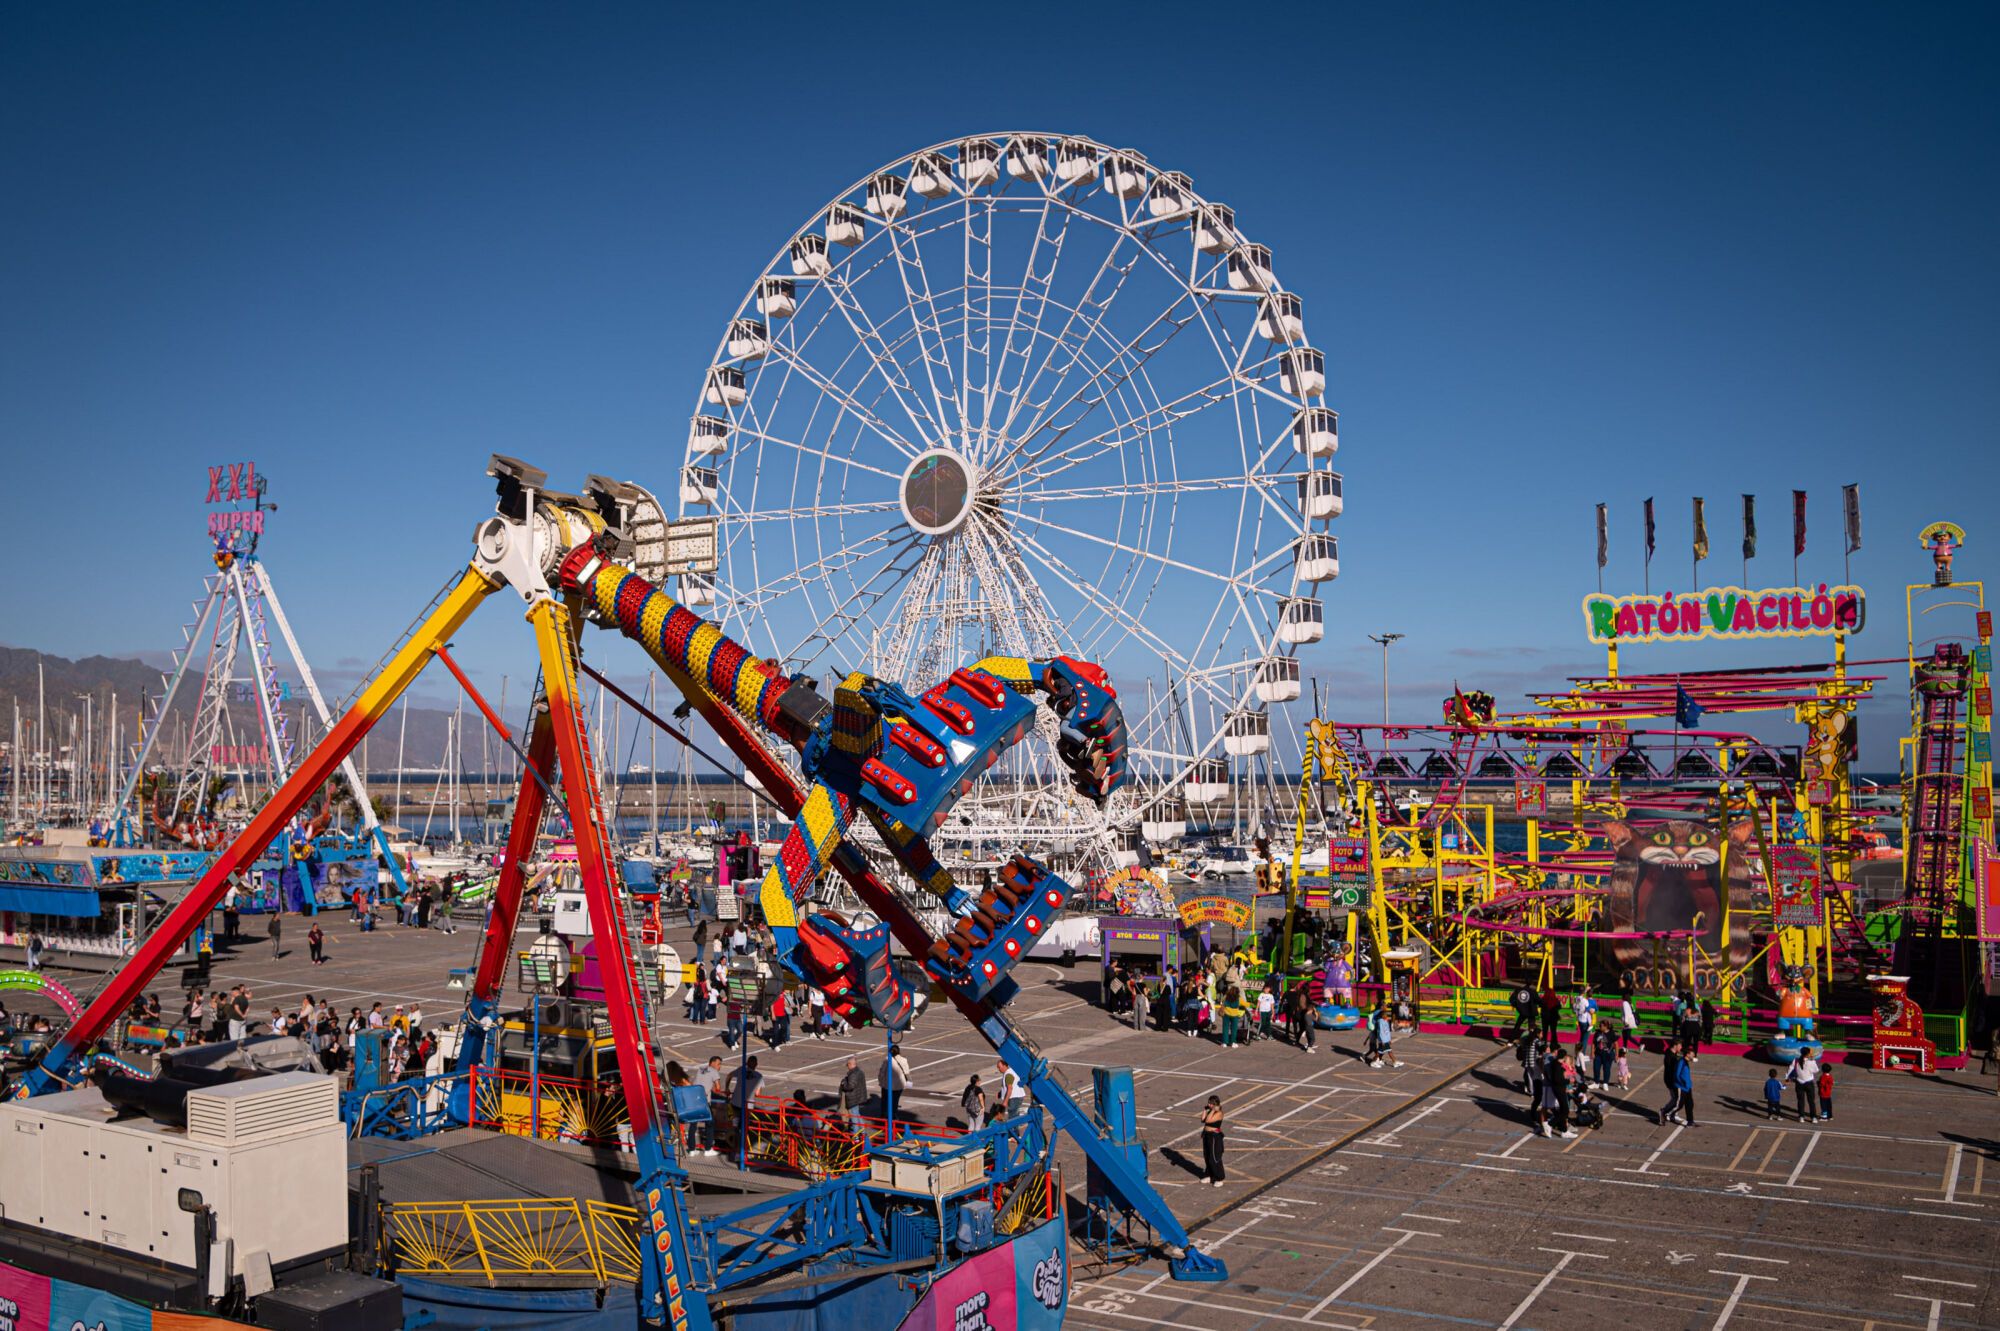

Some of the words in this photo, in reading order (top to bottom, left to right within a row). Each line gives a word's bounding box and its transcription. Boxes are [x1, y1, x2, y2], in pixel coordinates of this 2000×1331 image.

[205, 461, 258, 503] XXL
[207, 510, 264, 535] SUPER
[1590, 591, 1700, 638] RATÓN
[1707, 583, 1856, 632] VACILÓN
[1334, 848, 1353, 856] FOTO
[1335, 864, 1366, 872] E-MAIL
[1333, 882, 1367, 890] WhatsApp
[955, 1291, 987, 1321] more
